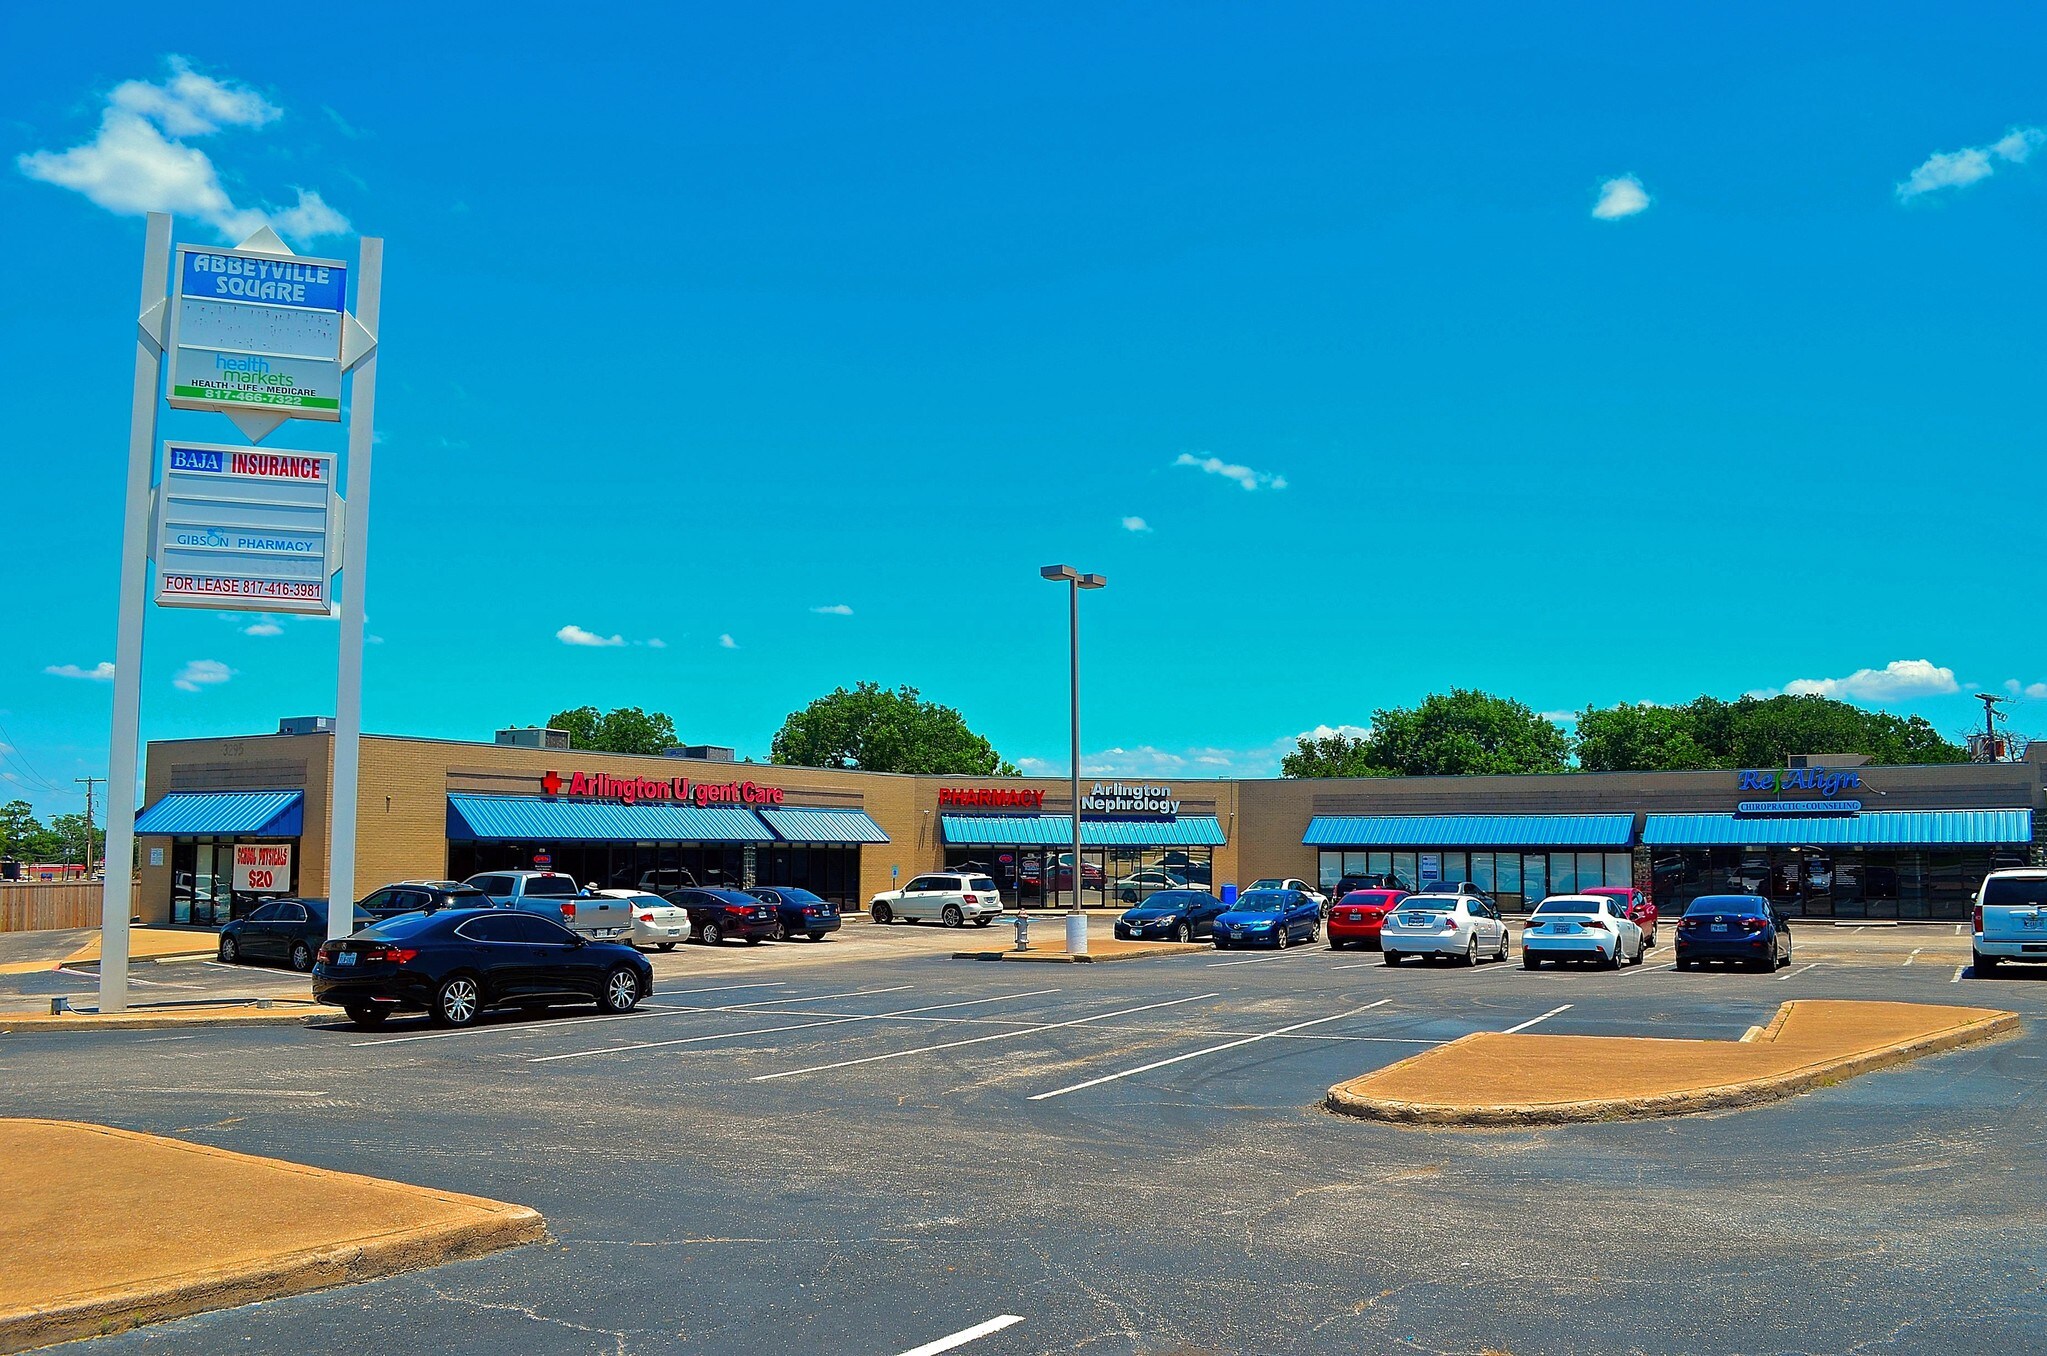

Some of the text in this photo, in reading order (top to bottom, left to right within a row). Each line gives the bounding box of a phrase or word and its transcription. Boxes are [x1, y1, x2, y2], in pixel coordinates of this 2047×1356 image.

[194, 254, 330, 285] ABBEYVILLE
[216, 276, 306, 303] SQUARE
[216, 354, 269, 373] health
[223, 370, 294, 386] markets
[191, 379, 316, 397] HEALTH LIFE MEDICARE
[204, 389, 302, 405] 817-466-7322
[174, 451, 321, 479] BAJA INSURANCE
[177, 533, 313, 552] GIBSON PHARMACY
[166, 576, 321, 597] FOR LEASE 817-416-3981
[569, 771, 784, 805] Arlington Urgent Care
[939, 787, 1046, 808] PHARMACY
[1090, 783, 1172, 799] Arlington
[1081, 796, 1181, 814] Nephrology
[1741, 801, 1859, 811] CHIROPRACTIC COUNSELING
[248, 869, 273, 888] $20
